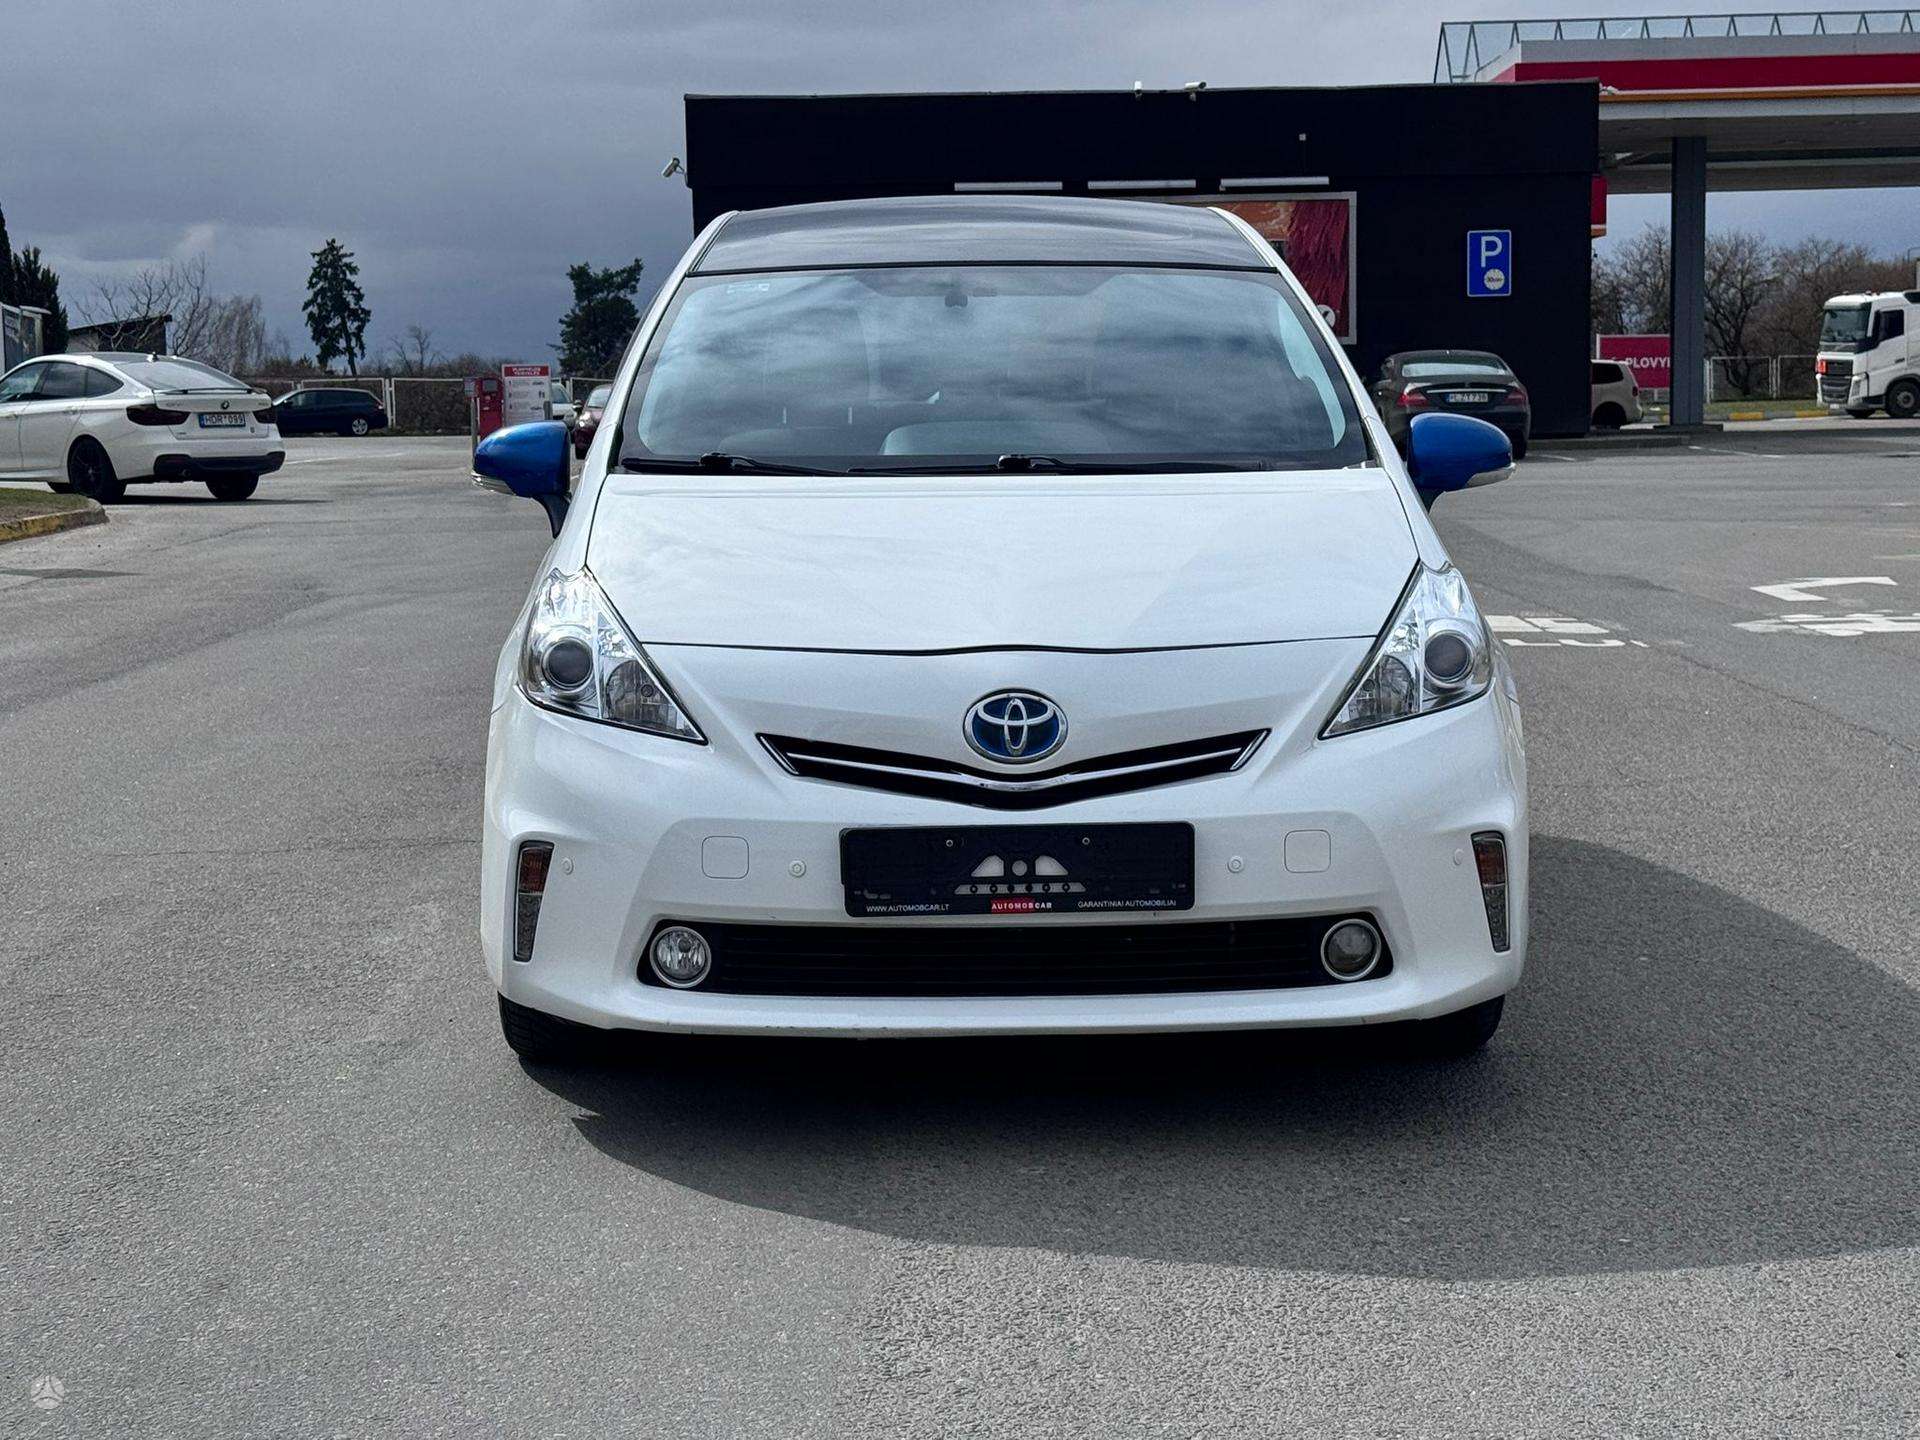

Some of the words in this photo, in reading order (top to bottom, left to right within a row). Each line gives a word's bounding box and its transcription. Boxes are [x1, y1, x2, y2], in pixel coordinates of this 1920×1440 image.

[1481, 236, 1502, 267] P
[866, 903, 950, 912] WWW.AUTOMOBCAR.LT
[991, 901, 1052, 910] AUTOMOBCAR
[1077, 900, 1124, 909] GARANTINIAI
[1125, 899, 1177, 908] AUTOMOBILIAI
